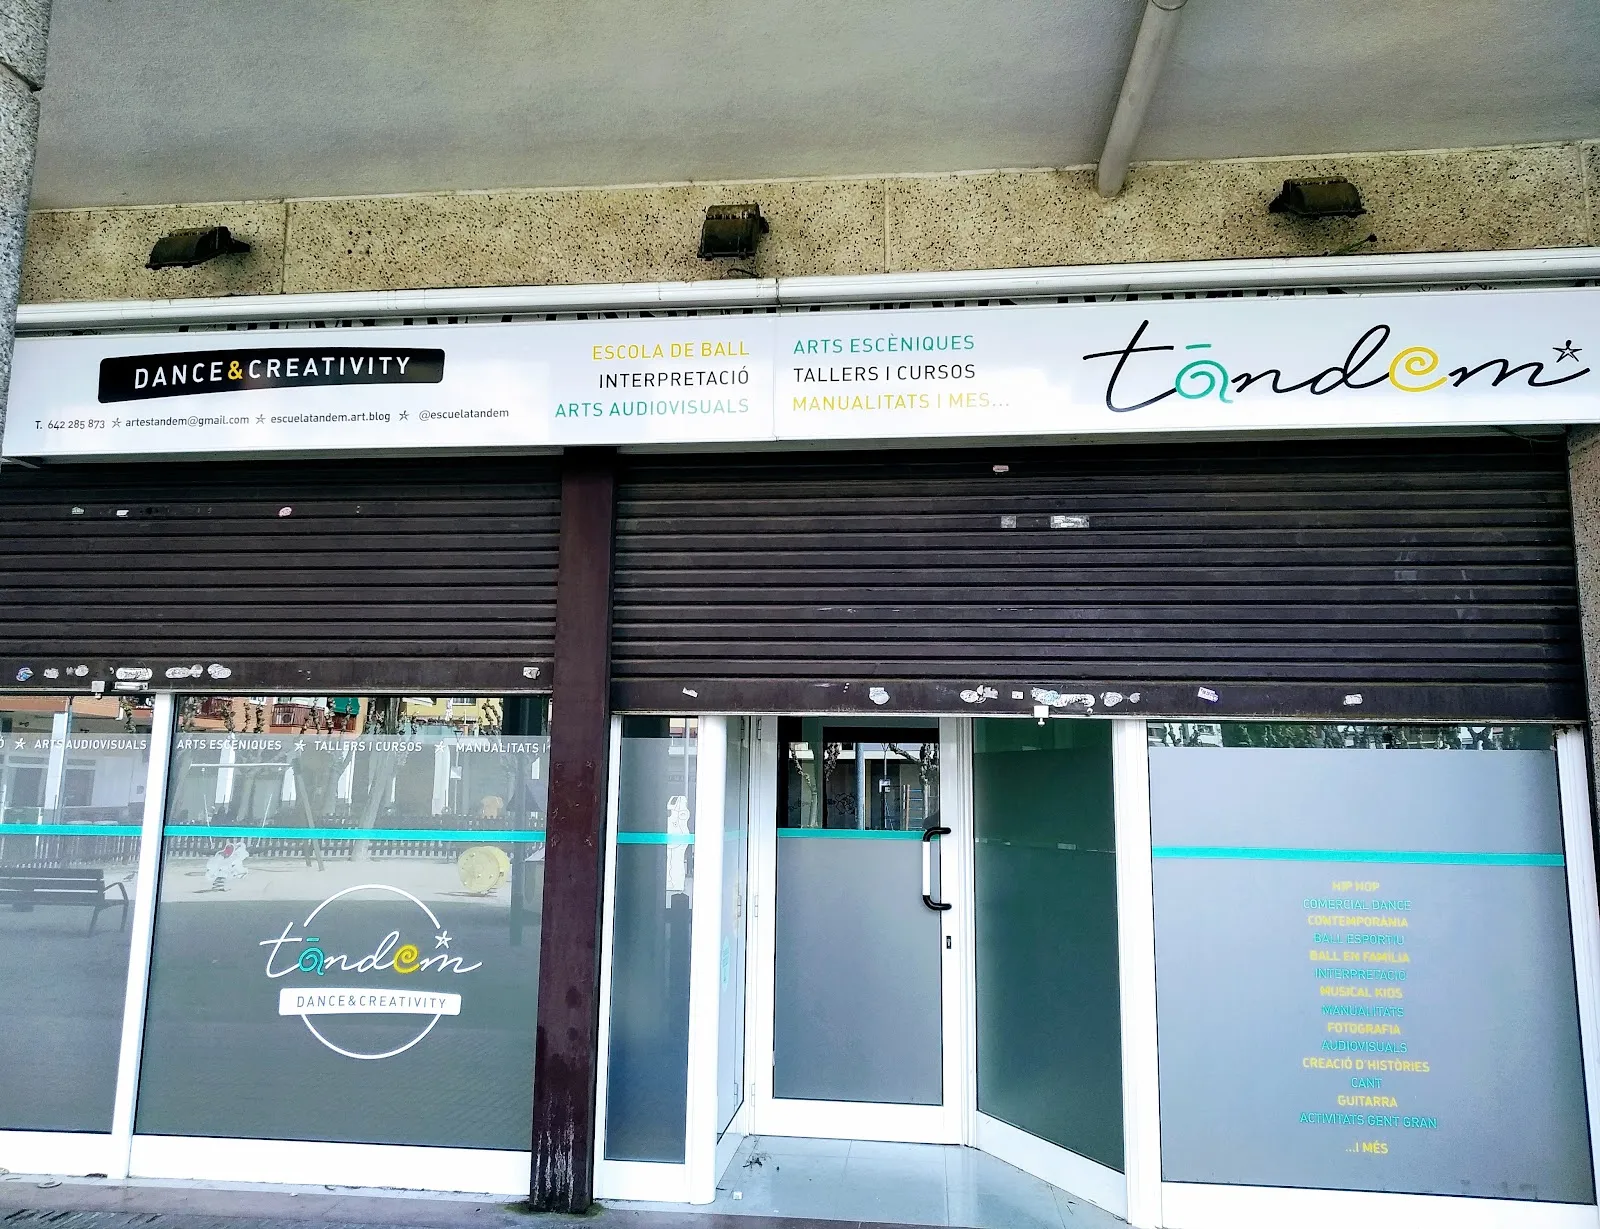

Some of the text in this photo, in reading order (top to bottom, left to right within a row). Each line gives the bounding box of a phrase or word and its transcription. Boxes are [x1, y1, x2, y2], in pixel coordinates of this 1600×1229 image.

[793, 333, 975, 354] ARTS ESCÈNIQUES
[592, 341, 750, 360] ESCOLA DE BALL
[134, 356, 411, 390] DANCE&CREATIVITY
[599, 366, 749, 389] INTERPRETACIÓ
[793, 364, 976, 383] TALLERS I CURSOS
[555, 398, 749, 418] ARTS AUDIOVISUALS
[792, 394, 930, 412] MANUALITATS
[937, 394, 941, 408] I
[270, 411, 390, 424] escuelatandem.art.blog
[418, 408, 509, 421] @escuelatandem
[35, 414, 250, 430] T. 642 285 873 artestandem@gmail.com
[34, 738, 147, 750] ARTS AUDIOVISUALS
[177, 738, 207, 750] ARTS
[314, 740, 366, 751] TALLERS
[375, 741, 422, 752] CURSOS
[455, 742, 539, 753] MANUALITATS
[1332, 881, 1380, 893] HIP HOP
[1303, 899, 1412, 911] COMERCIAL DANCE
[1314, 933, 1405, 945] BALL ESPORTIU
[1309, 950, 1341, 962] BALL
[1343, 951, 1360, 962] EN
[1320, 986, 1403, 999] MUSICAL KIDS
[296, 994, 447, 1009] DANCE&CREATIVITY
[1322, 1004, 1404, 1017] MANUALITATS
[1327, 1022, 1401, 1035] FOTOGRAFIA
[1322, 1040, 1408, 1053] AUDIOVISUALS
[1303, 1056, 1353, 1069] CREACIÓ
[1351, 1077, 1382, 1088] CANT
[1337, 1095, 1398, 1107] GUITARRA
[1300, 1112, 1437, 1129] ACTIVITATS GENT GRAN
[1362, 1140, 1389, 1154] MÉS
